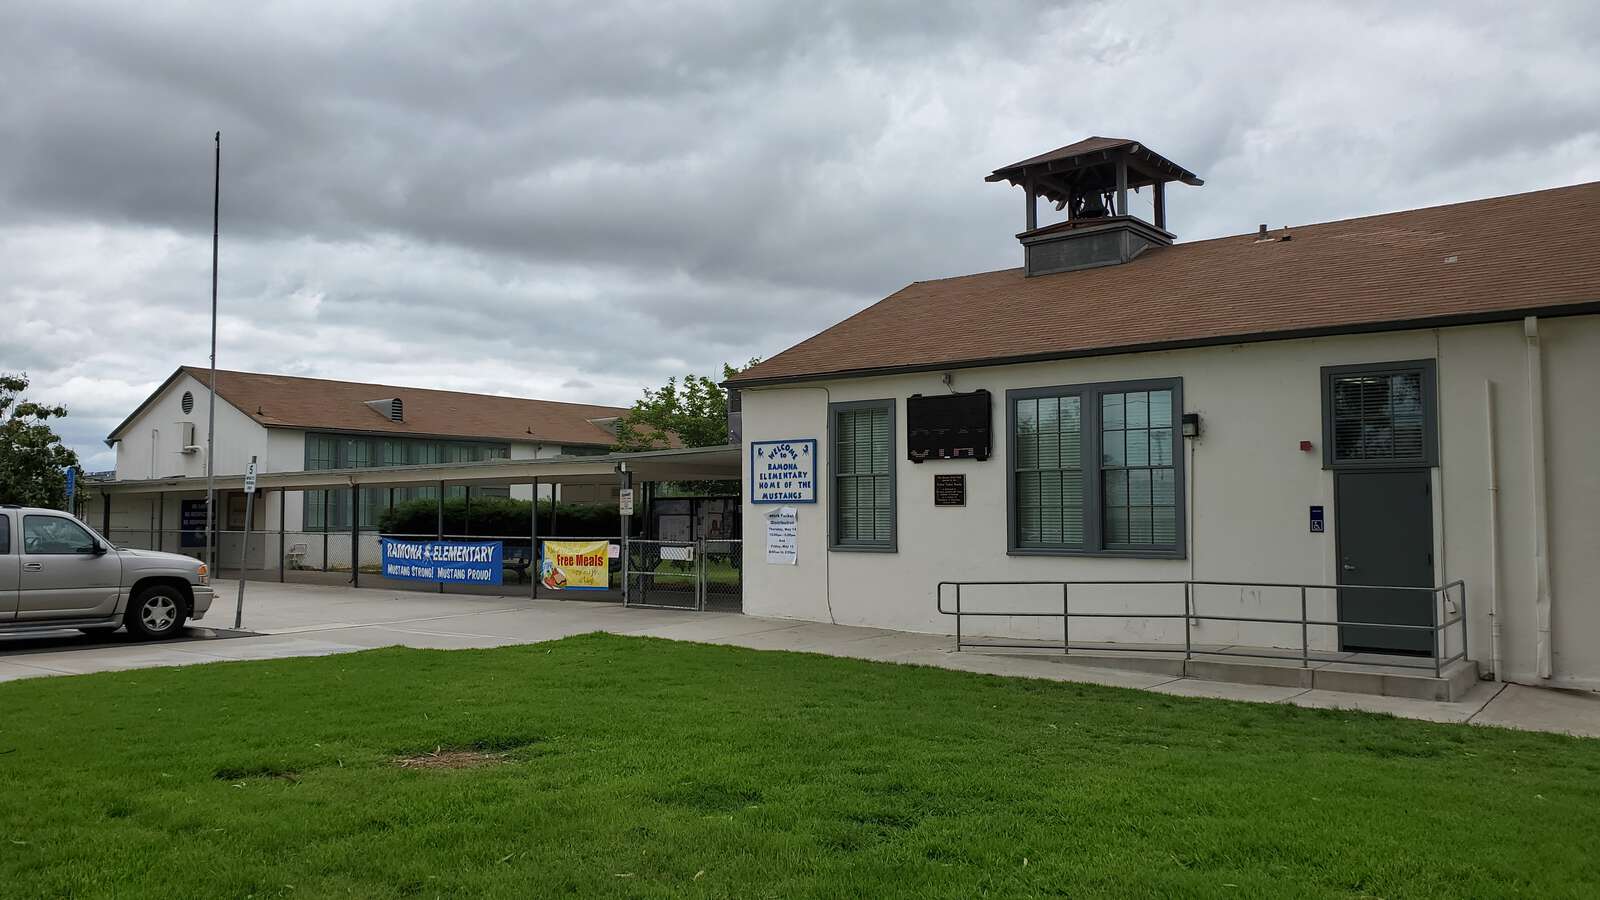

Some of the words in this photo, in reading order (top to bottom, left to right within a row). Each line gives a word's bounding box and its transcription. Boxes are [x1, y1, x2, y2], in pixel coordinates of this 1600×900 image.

[768, 444, 798, 460] WELCOME
[760, 472, 808, 480] ELEMENTARY
[387, 543, 422, 560] RAMONA
[433, 545, 494, 562] ELEMENTARY
[556, 554, 574, 566] Free
[576, 554, 604, 566] Meals
[387, 563, 411, 577] MUSTANG
[411, 565, 434, 579] STRONG!
[437, 567, 466, 580] MUSTANG
[467, 568, 492, 581] PROUD!
